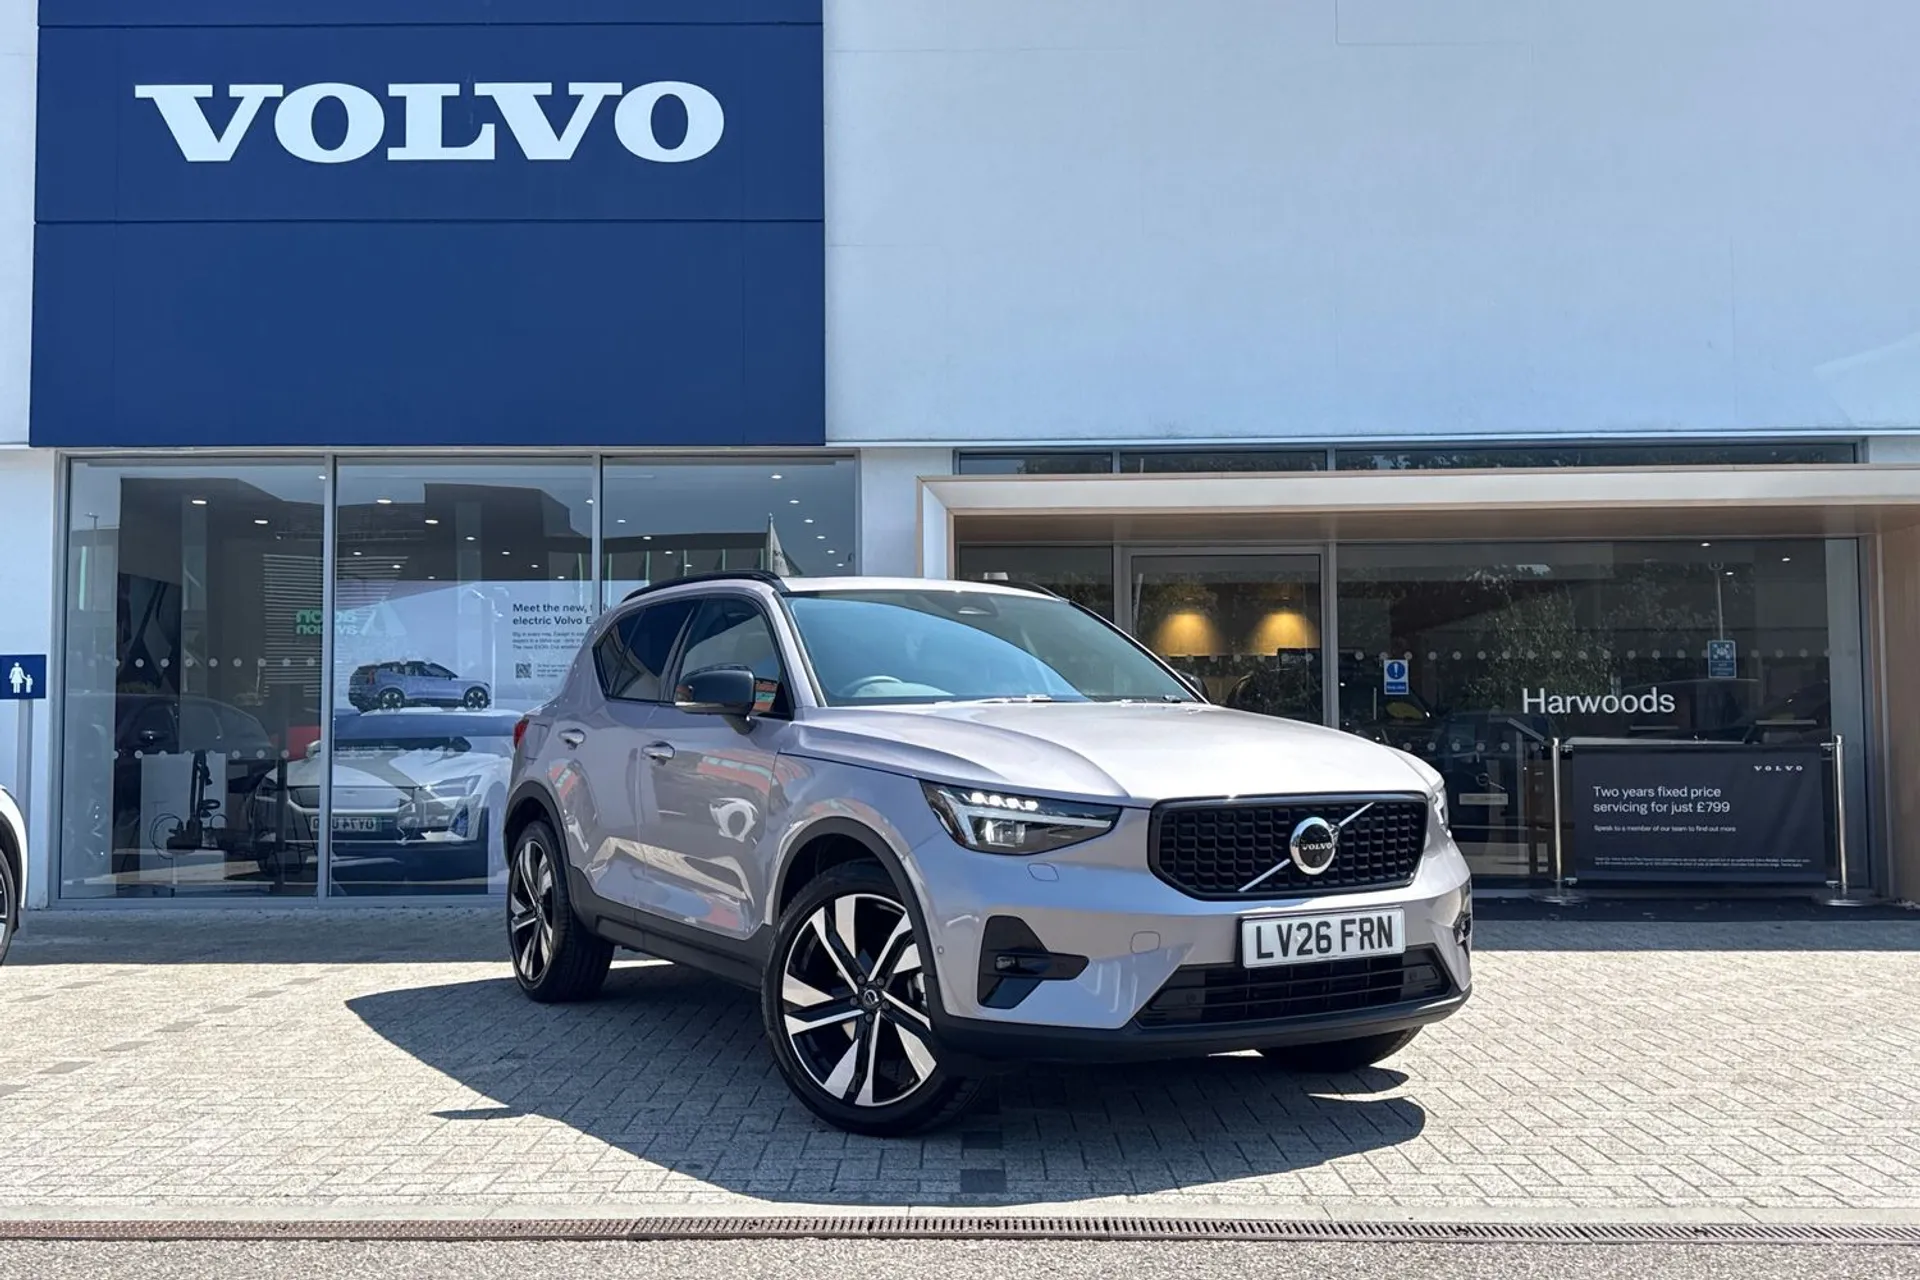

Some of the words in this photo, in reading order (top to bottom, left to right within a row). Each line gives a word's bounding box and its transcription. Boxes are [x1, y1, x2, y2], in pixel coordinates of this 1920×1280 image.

[135, 81, 724, 163] VOLVO
[513, 603, 540, 613] Meet
[542, 603, 560, 613] the
[562, 605, 588, 614] new,
[513, 616, 552, 625] electric
[554, 616, 583, 625] Volvo
[1522, 686, 1676, 714] Harwoods
[1593, 786, 1620, 797] Two
[1622, 788, 1655, 799] years
[1657, 786, 1688, 797] fixed
[1690, 786, 1721, 799] price
[1593, 802, 1648, 815] servicing
[1650, 802, 1668, 812] for
[1670, 802, 1693, 815] just
[1696, 801, 1730, 813] £799
[1301, 842, 1333, 851] VOLVO
[1256, 920, 1332, 959] LV26
[1341, 916, 1393, 952] FRN
